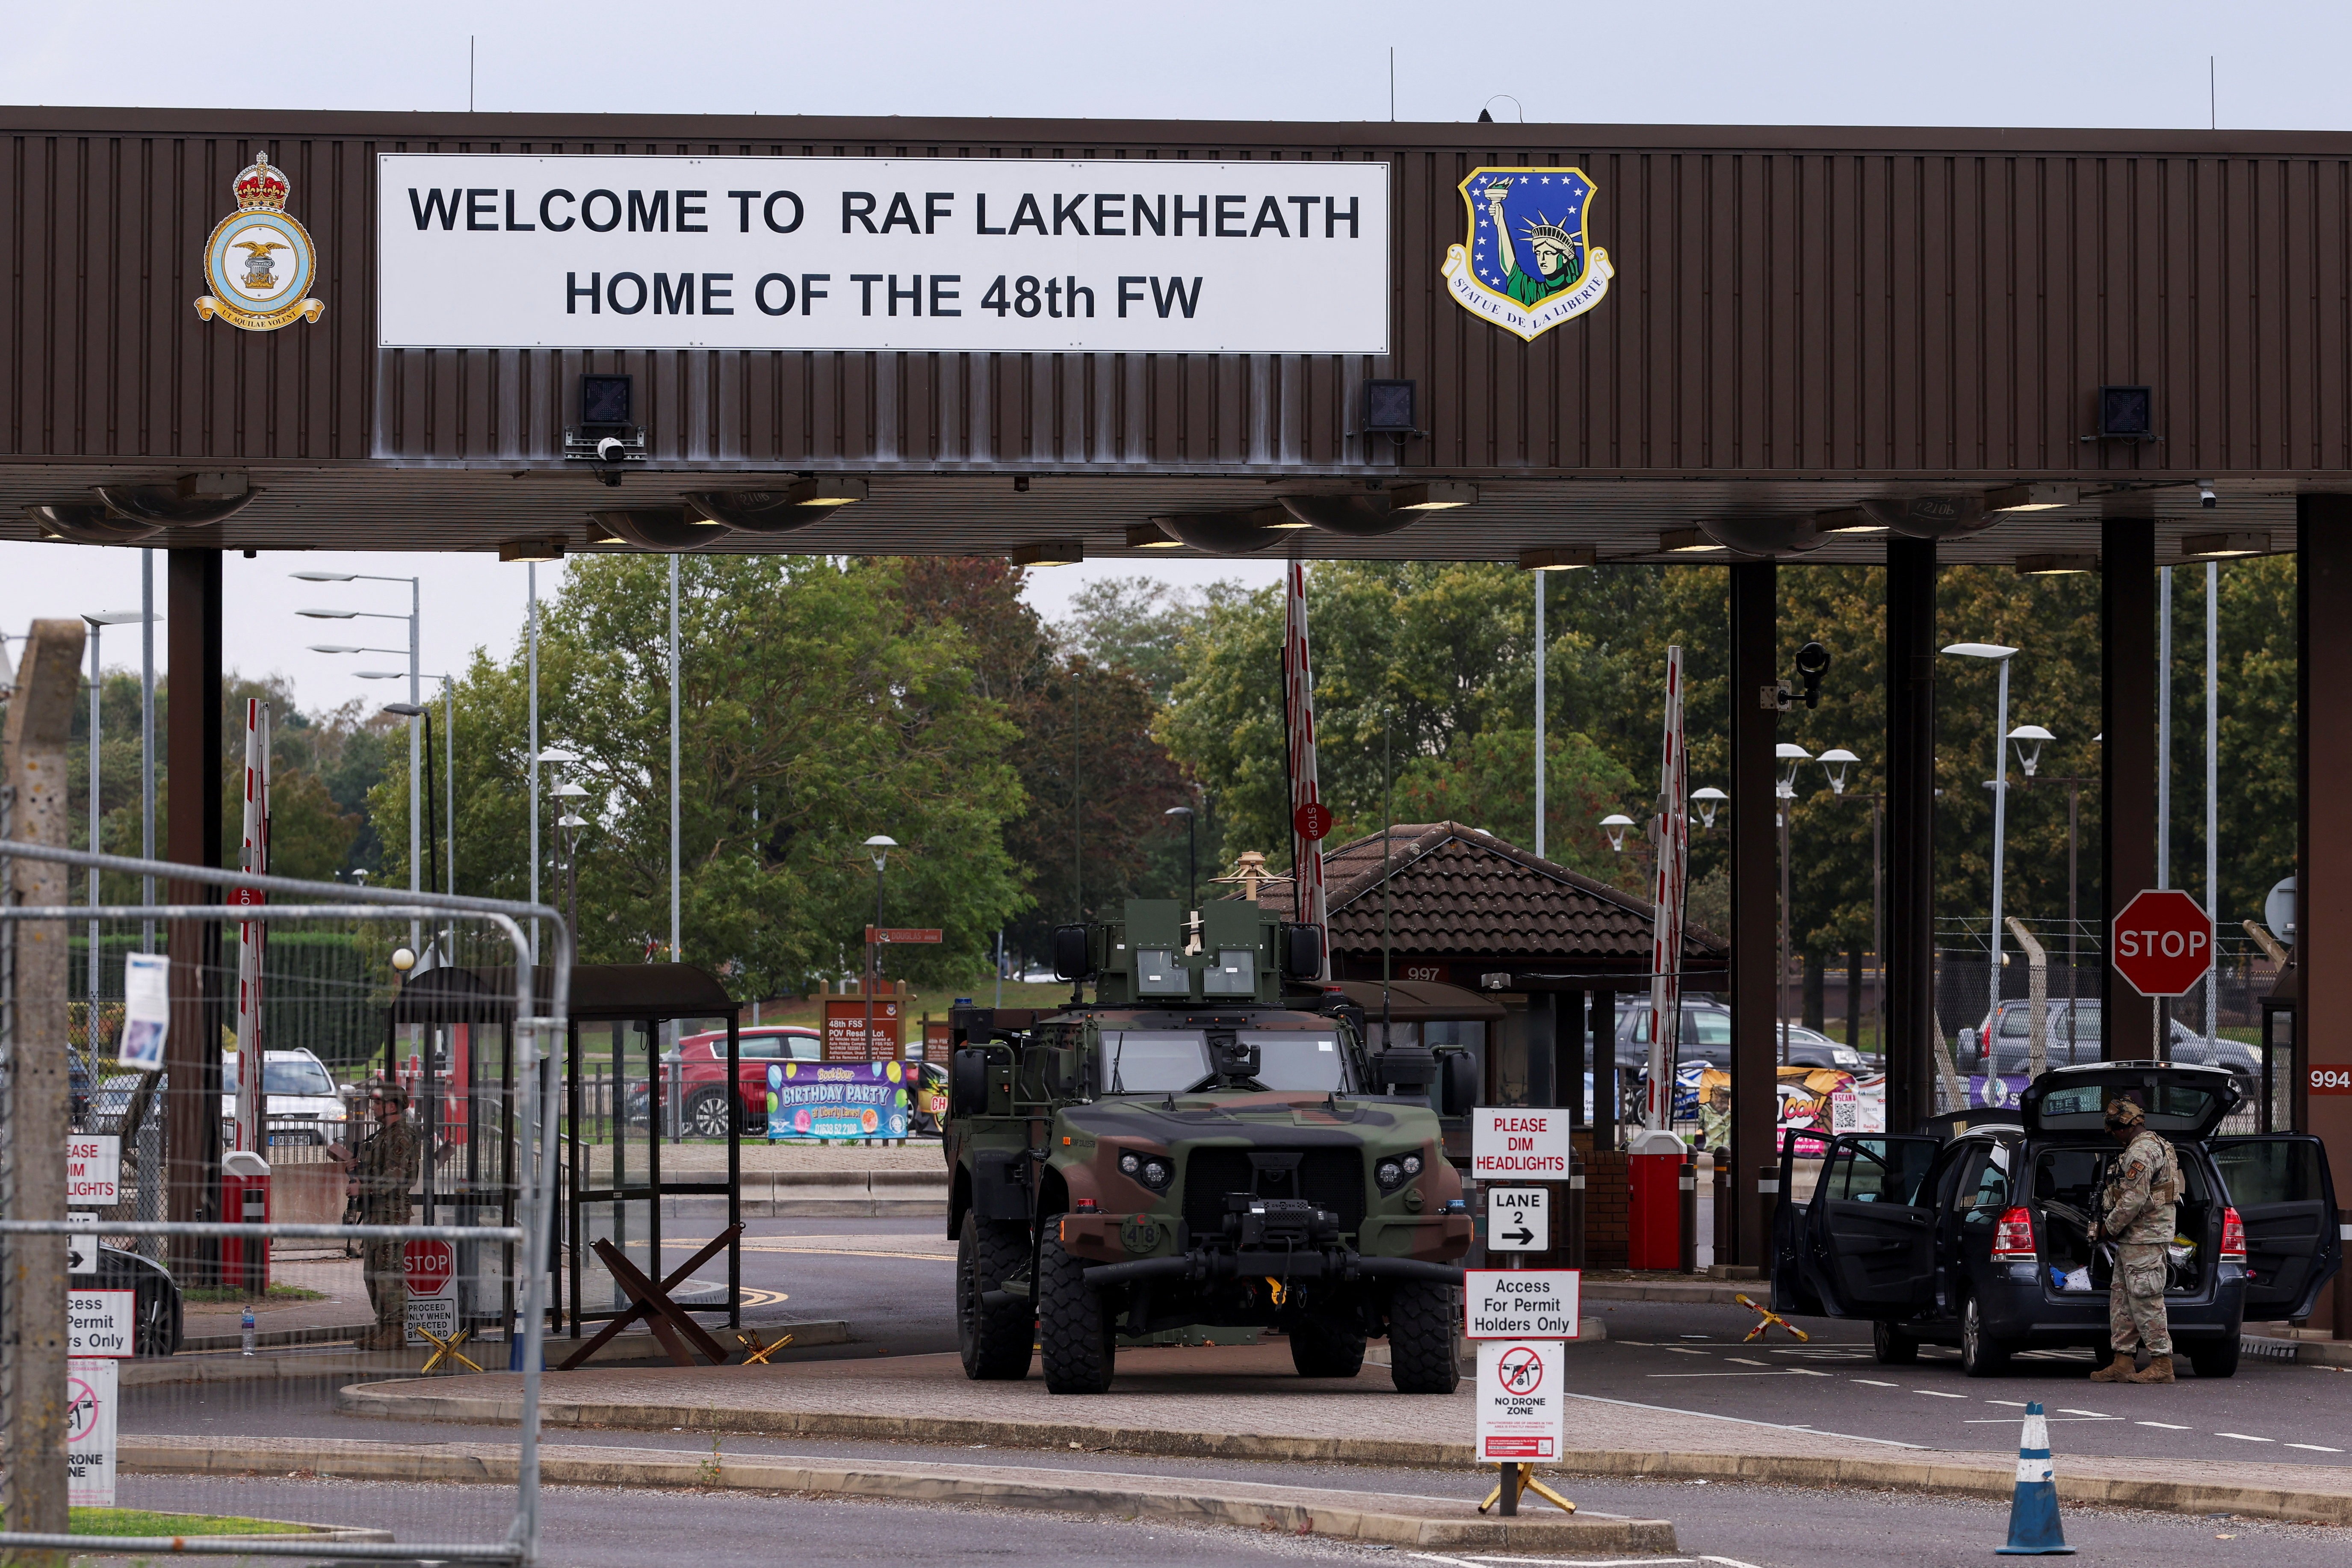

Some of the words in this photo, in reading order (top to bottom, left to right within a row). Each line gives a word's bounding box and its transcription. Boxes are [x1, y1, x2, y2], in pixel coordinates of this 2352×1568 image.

[408, 188, 708, 232] WELCOME
[728, 191, 804, 233] TO
[842, 192, 954, 234] RAF
[977, 193, 1358, 238] LAKENHEATH
[215, 230, 233, 258] ROYAL
[233, 219, 248, 230] AIR
[250, 215, 283, 226] FORCE
[284, 224, 307, 260] STATION
[228, 292, 292, 310] LAKENHEATH
[567, 272, 734, 315] HOME
[755, 273, 830, 316] OF
[851, 275, 961, 316] THE
[981, 275, 1094, 318] 48th
[1118, 276, 1203, 318] FW
[1454, 278, 1501, 314] STATUE
[1507, 313, 1526, 328] DE
[1533, 313, 1552, 329] LA
[1554, 276, 1603, 316] LIBERTE
[222, 310, 233, 319] UT
[233, 316, 266, 328] AQUILAE
[269, 310, 296, 326] VOLENT
[1307, 807, 1318, 837] STOP
[2120, 930, 2206, 957] STOP
[1408, 968, 1439, 981] 997
[818, 1069, 836, 1081] Book
[836, 1068, 854, 1082] Your
[2311, 1071, 2350, 1087] 994
[783, 1084, 845, 1107] BIRTHDAY
[846, 1084, 891, 1106] PARTY
[812, 1108, 818, 1118] at
[820, 1107, 841, 1119] Liberty
[1783, 1095, 1828, 1120] CON!
[815, 1124, 833, 1134] 01638
[834, 1124, 842, 1134] 52
[842, 1124, 857, 1134] 2108
[1495, 1118, 1546, 1132] PLEASE
[1509, 1137, 1533, 1150] DIM
[66, 1145, 98, 1158] EASE
[1477, 1157, 1563, 1170] HEADLIGHTS
[67, 1182, 113, 1196] LIGHTS
[1497, 1195, 1539, 1207] LANE
[1137, 1214, 1146, 1224] C
[1514, 1211, 1523, 1223] 2
[404, 1255, 447, 1272] STOP
[1496, 1279, 1549, 1292] Access
[68, 1299, 102, 1309] cess
[1485, 1299, 1507, 1311] For
[1515, 1298, 1560, 1311] Permit
[408, 1321, 447, 1329] DIRECTED
[1475, 1317, 1530, 1331] Holders
[1538, 1317, 1569, 1333] Only
[89, 1334, 123, 1349] Only
[68, 1454, 103, 1465] RONE
[68, 1467, 85, 1477] NE
